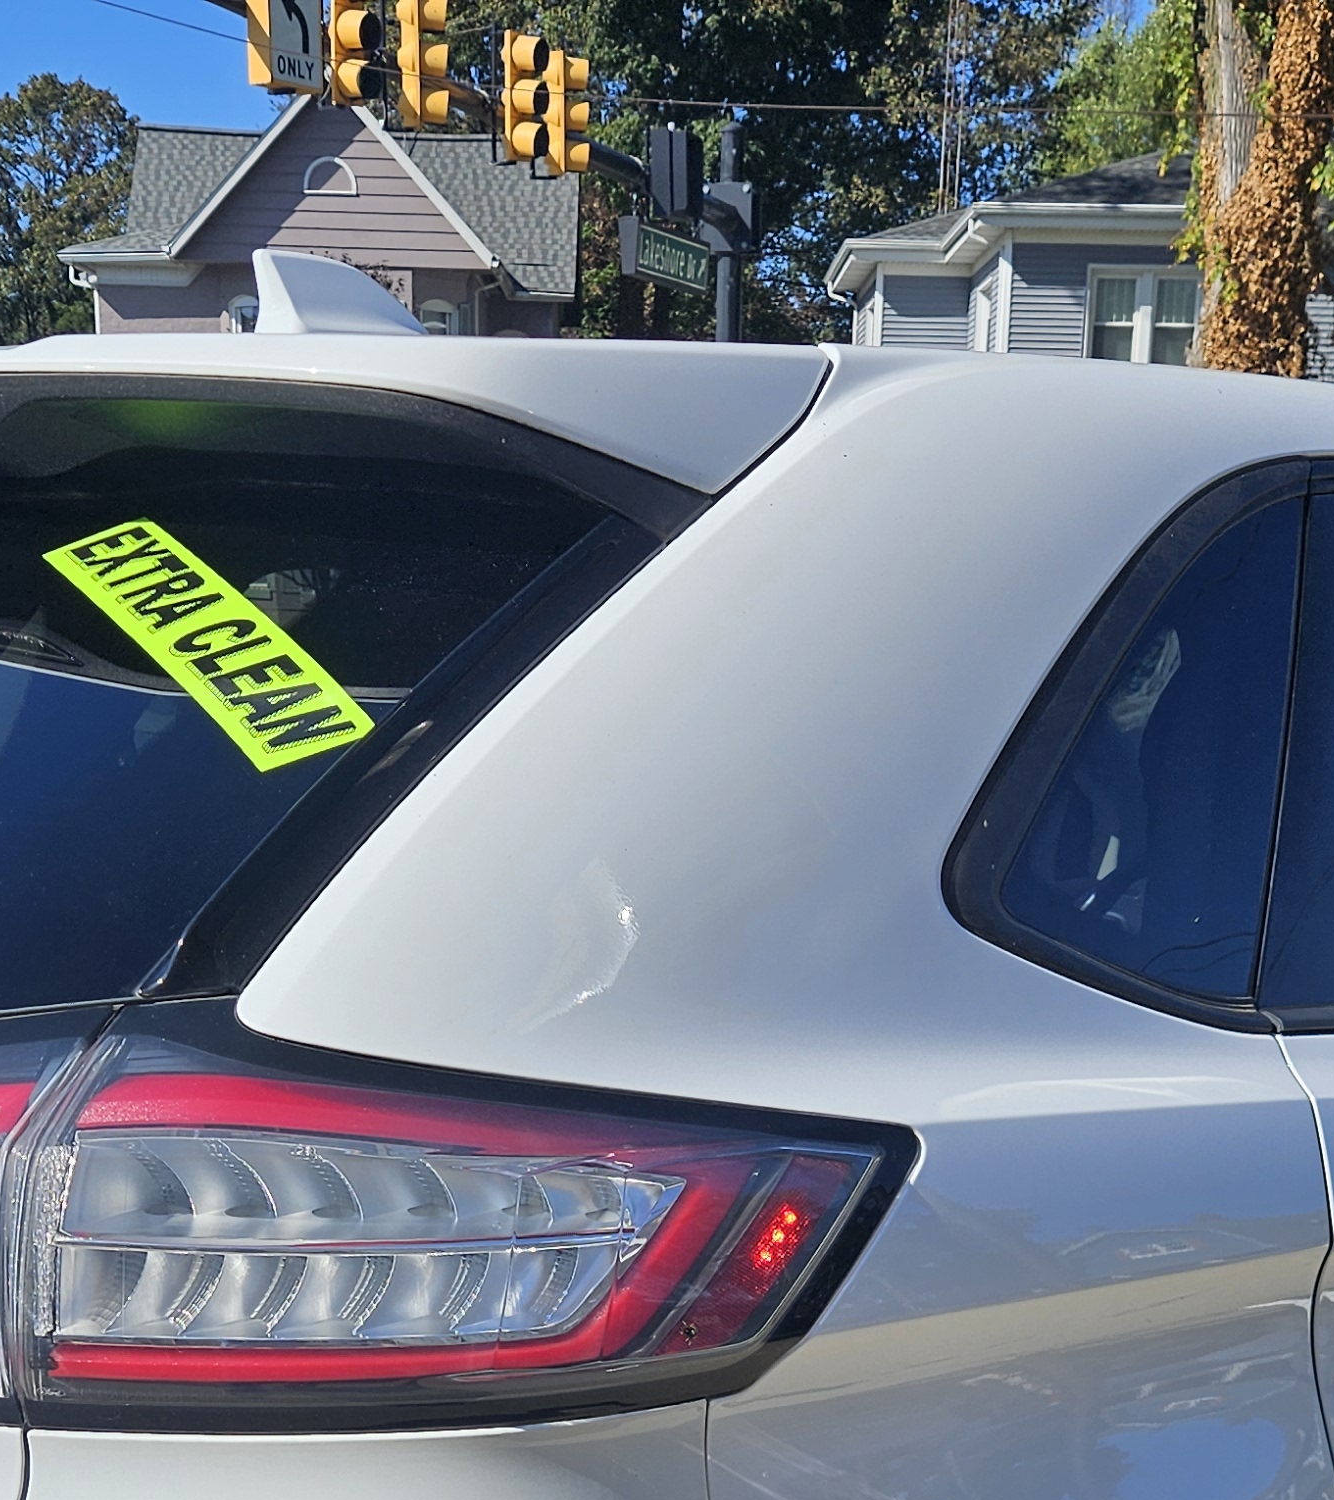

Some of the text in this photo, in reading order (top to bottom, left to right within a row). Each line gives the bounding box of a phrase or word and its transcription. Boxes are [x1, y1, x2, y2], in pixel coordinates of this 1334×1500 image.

[277, 54, 315, 81] ONLY
[65, 525, 357, 754] EXTRA CLEAN
